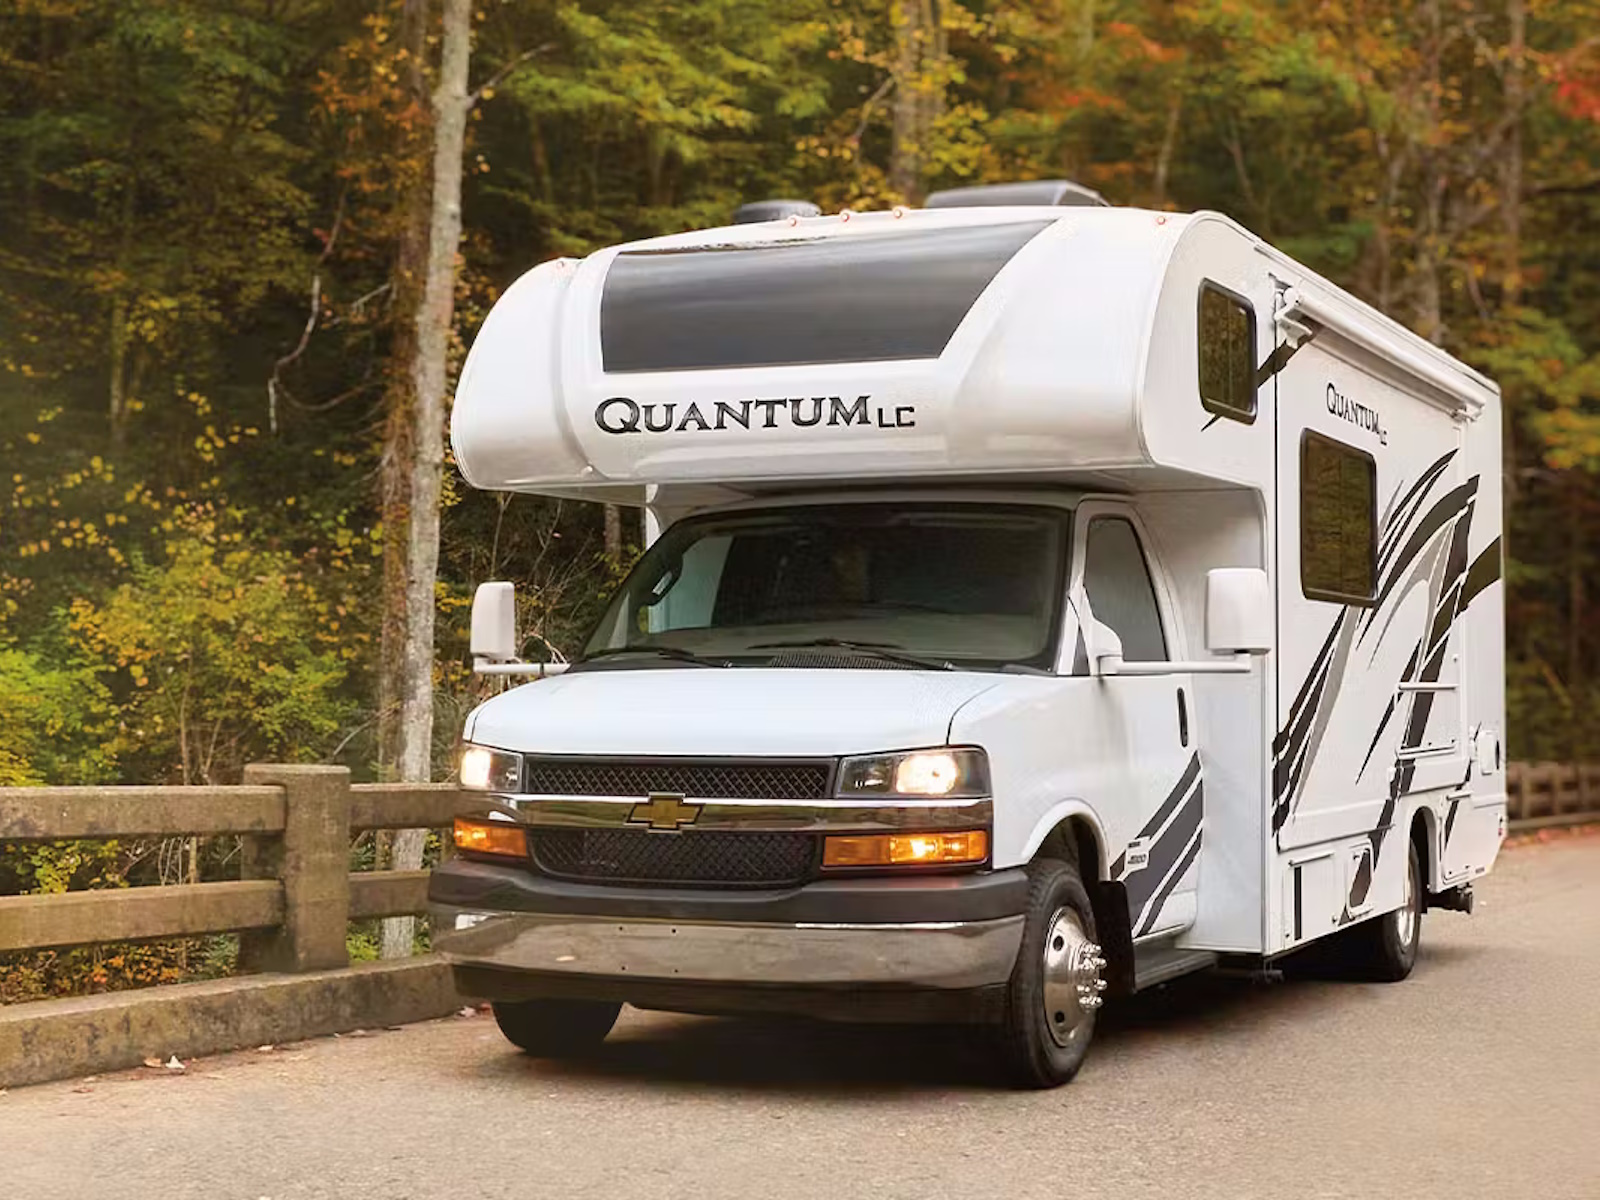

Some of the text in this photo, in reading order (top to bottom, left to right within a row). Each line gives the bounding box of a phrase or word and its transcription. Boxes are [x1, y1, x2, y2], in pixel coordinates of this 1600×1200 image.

[594, 395, 916, 434] QUANTUM LC
[1326, 382, 1380, 435] QUANTUM
